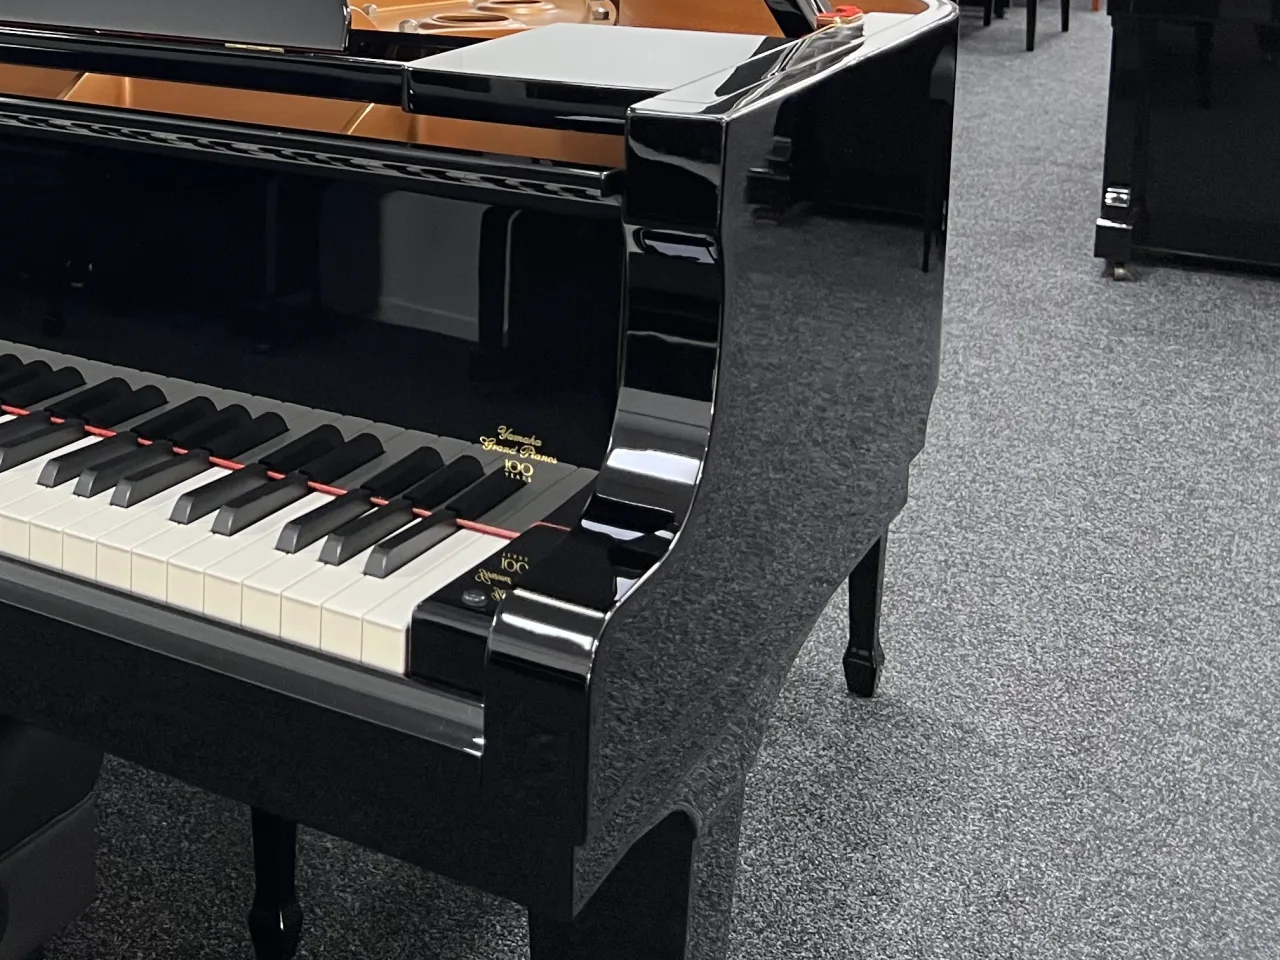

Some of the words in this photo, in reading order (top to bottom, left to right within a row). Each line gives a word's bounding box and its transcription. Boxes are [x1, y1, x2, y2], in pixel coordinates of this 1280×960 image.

[497, 425, 542, 447] Yamaha
[479, 436, 518, 455] Grand
[519, 445, 558, 464] Pianos
[504, 458, 534, 477] 100
